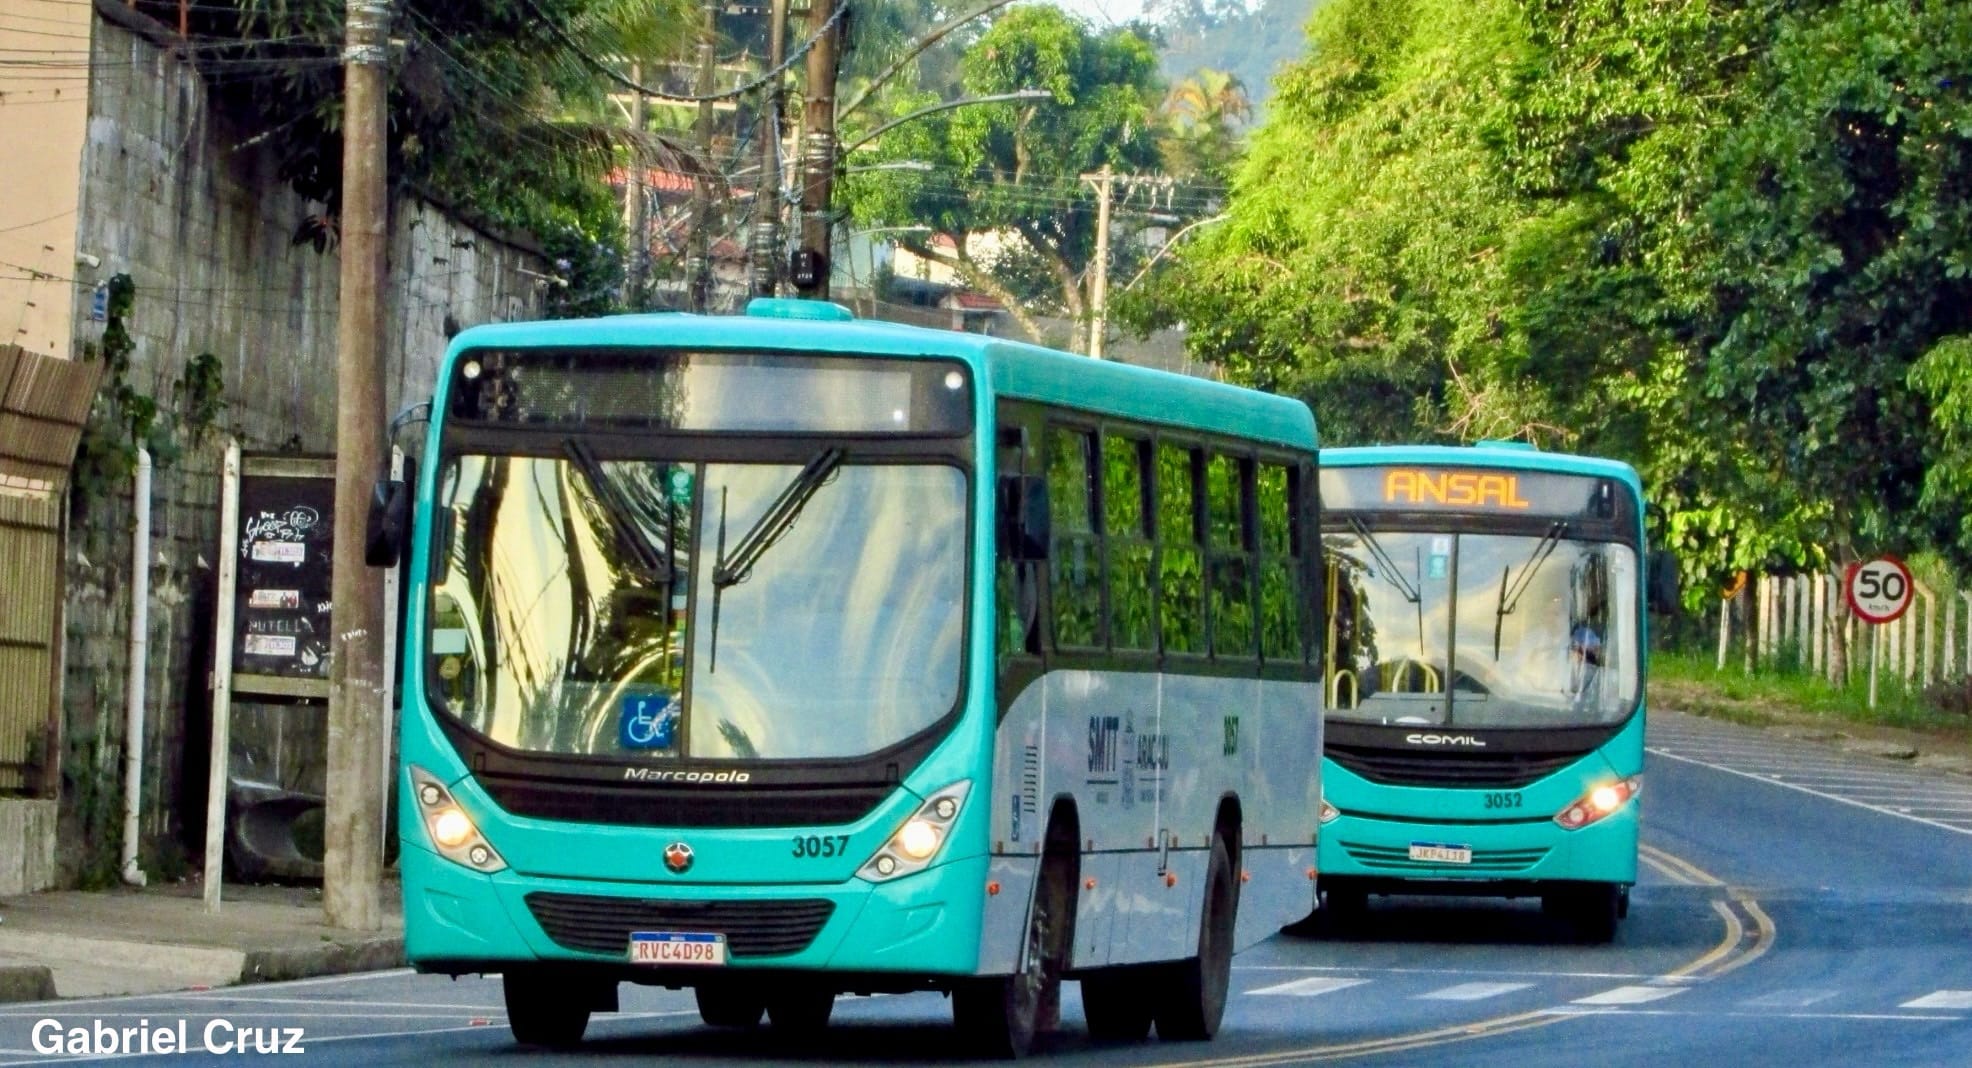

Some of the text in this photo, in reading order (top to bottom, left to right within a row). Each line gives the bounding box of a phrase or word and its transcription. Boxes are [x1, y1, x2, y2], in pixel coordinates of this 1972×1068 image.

[1387, 470, 1529, 507] ANSAL
[1859, 570, 1905, 601] 50
[1088, 716, 1120, 772] SMTT
[1406, 734, 1486, 746] COMIL
[624, 767, 750, 783] Marcopolo
[1484, 793, 1523, 808] 3052
[793, 835, 849, 858] 3057
[639, 942, 714, 960] RVC4D98
